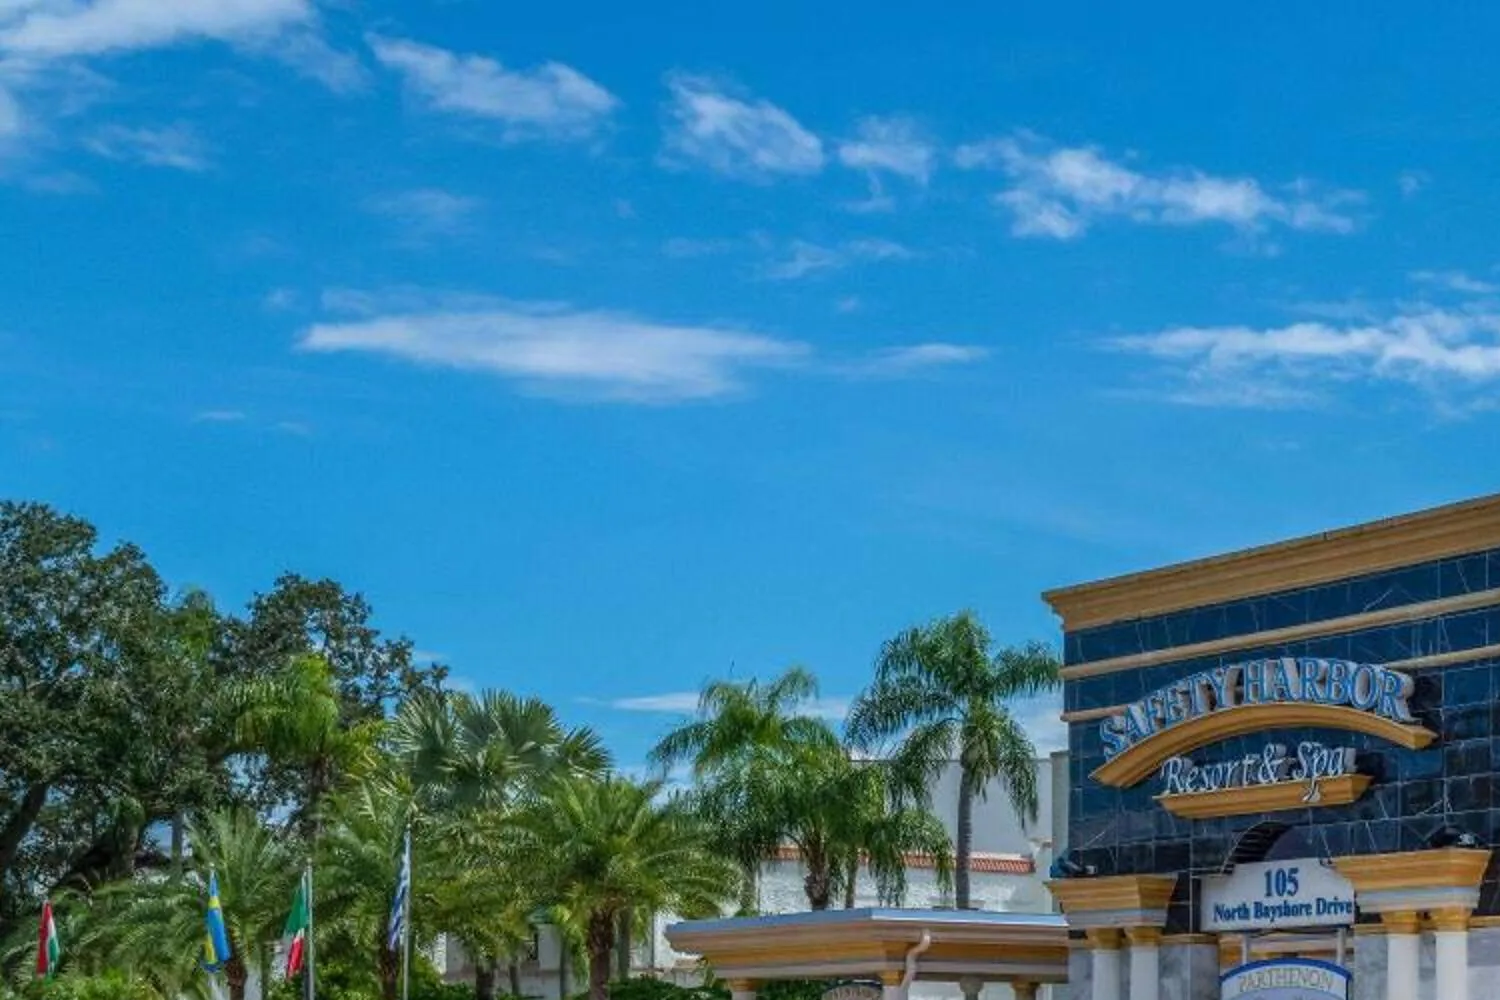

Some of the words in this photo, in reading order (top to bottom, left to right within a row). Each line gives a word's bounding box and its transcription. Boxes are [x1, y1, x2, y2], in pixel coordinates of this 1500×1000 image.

[1100, 667, 1236, 763] SAFETY
[1243, 657, 1416, 722] HARBOR
[1160, 753, 1258, 796] Resort
[1257, 743, 1286, 784] &
[1291, 741, 1347, 802] Spa
[1264, 867, 1299, 897] 105
[1213, 901, 1250, 922] North
[1253, 900, 1313, 922] Bayshore
[1315, 896, 1353, 916] Drive
